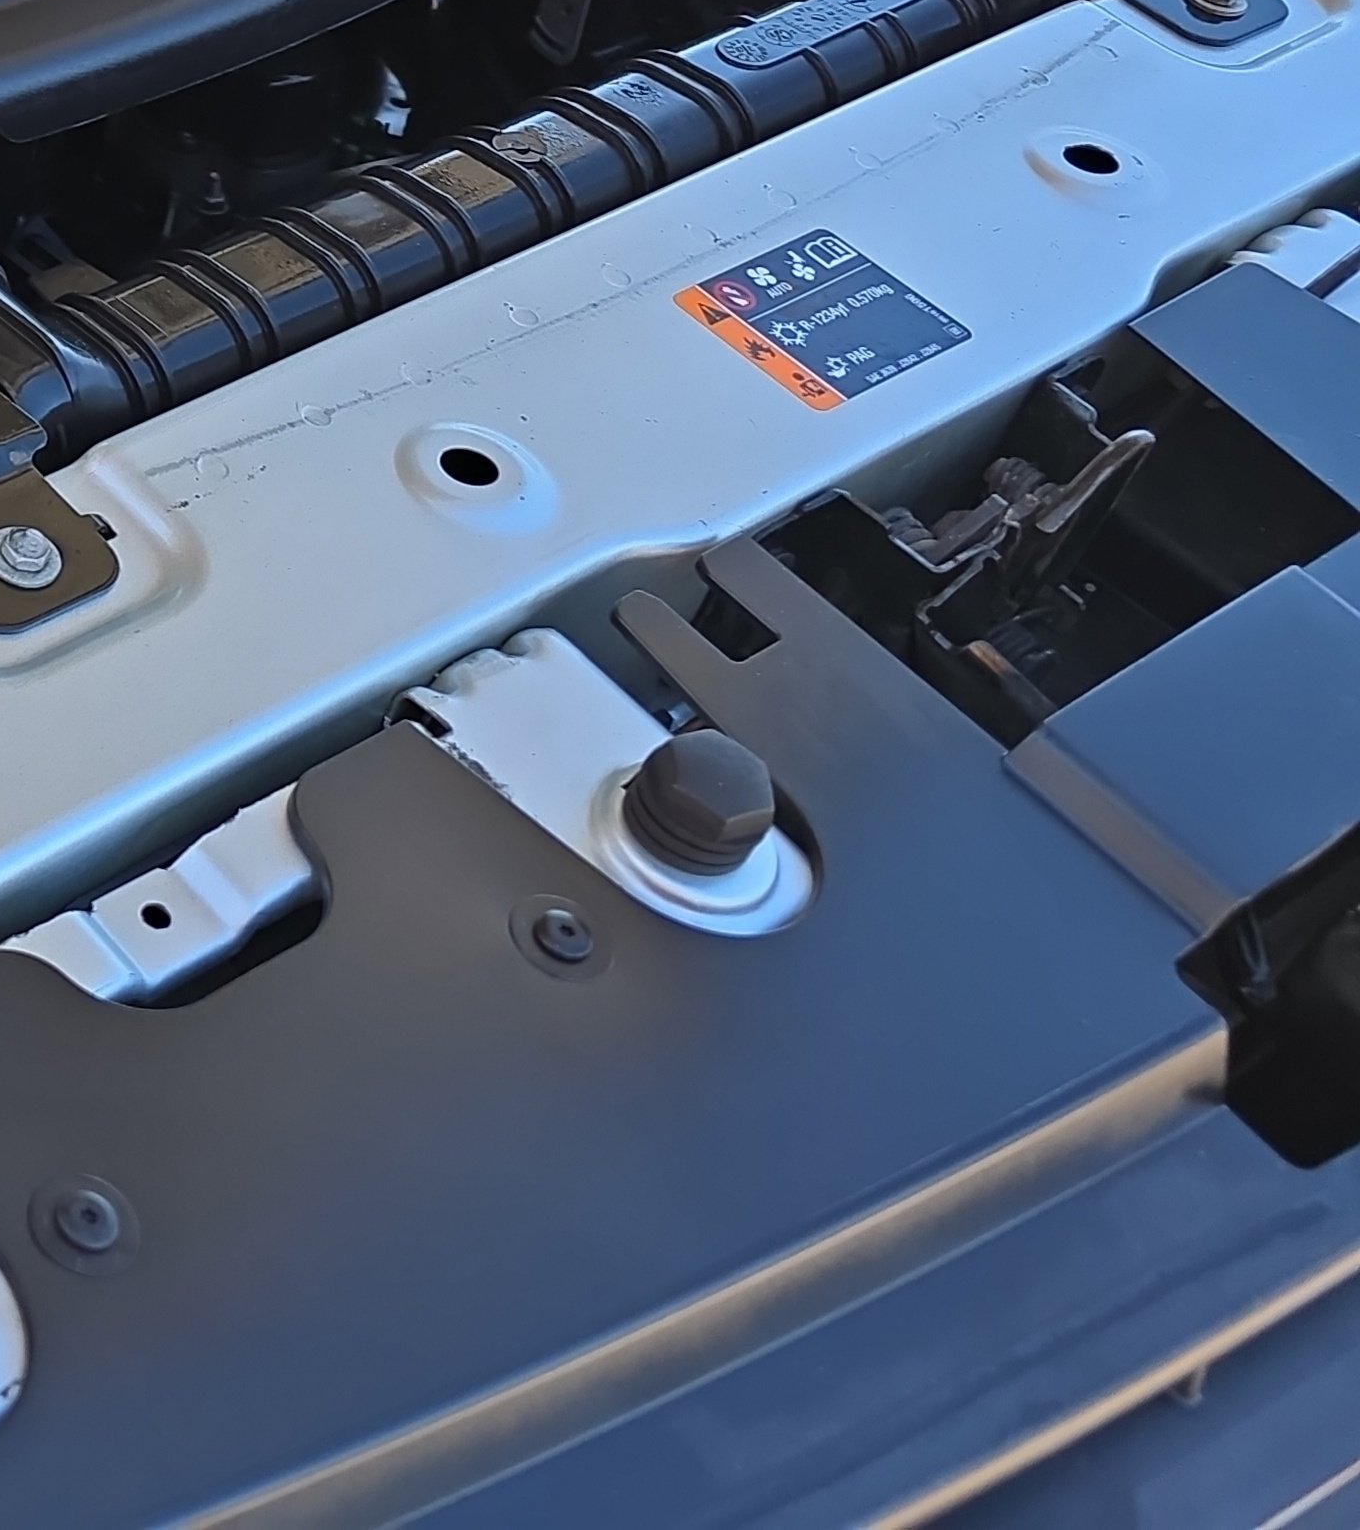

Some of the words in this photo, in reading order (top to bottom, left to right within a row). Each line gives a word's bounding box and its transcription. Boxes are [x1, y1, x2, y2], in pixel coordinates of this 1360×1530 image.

[767, 281, 794, 300] AUTO
[850, 283, 895, 309] 0.570kg
[847, 346, 877, 366] PAG
